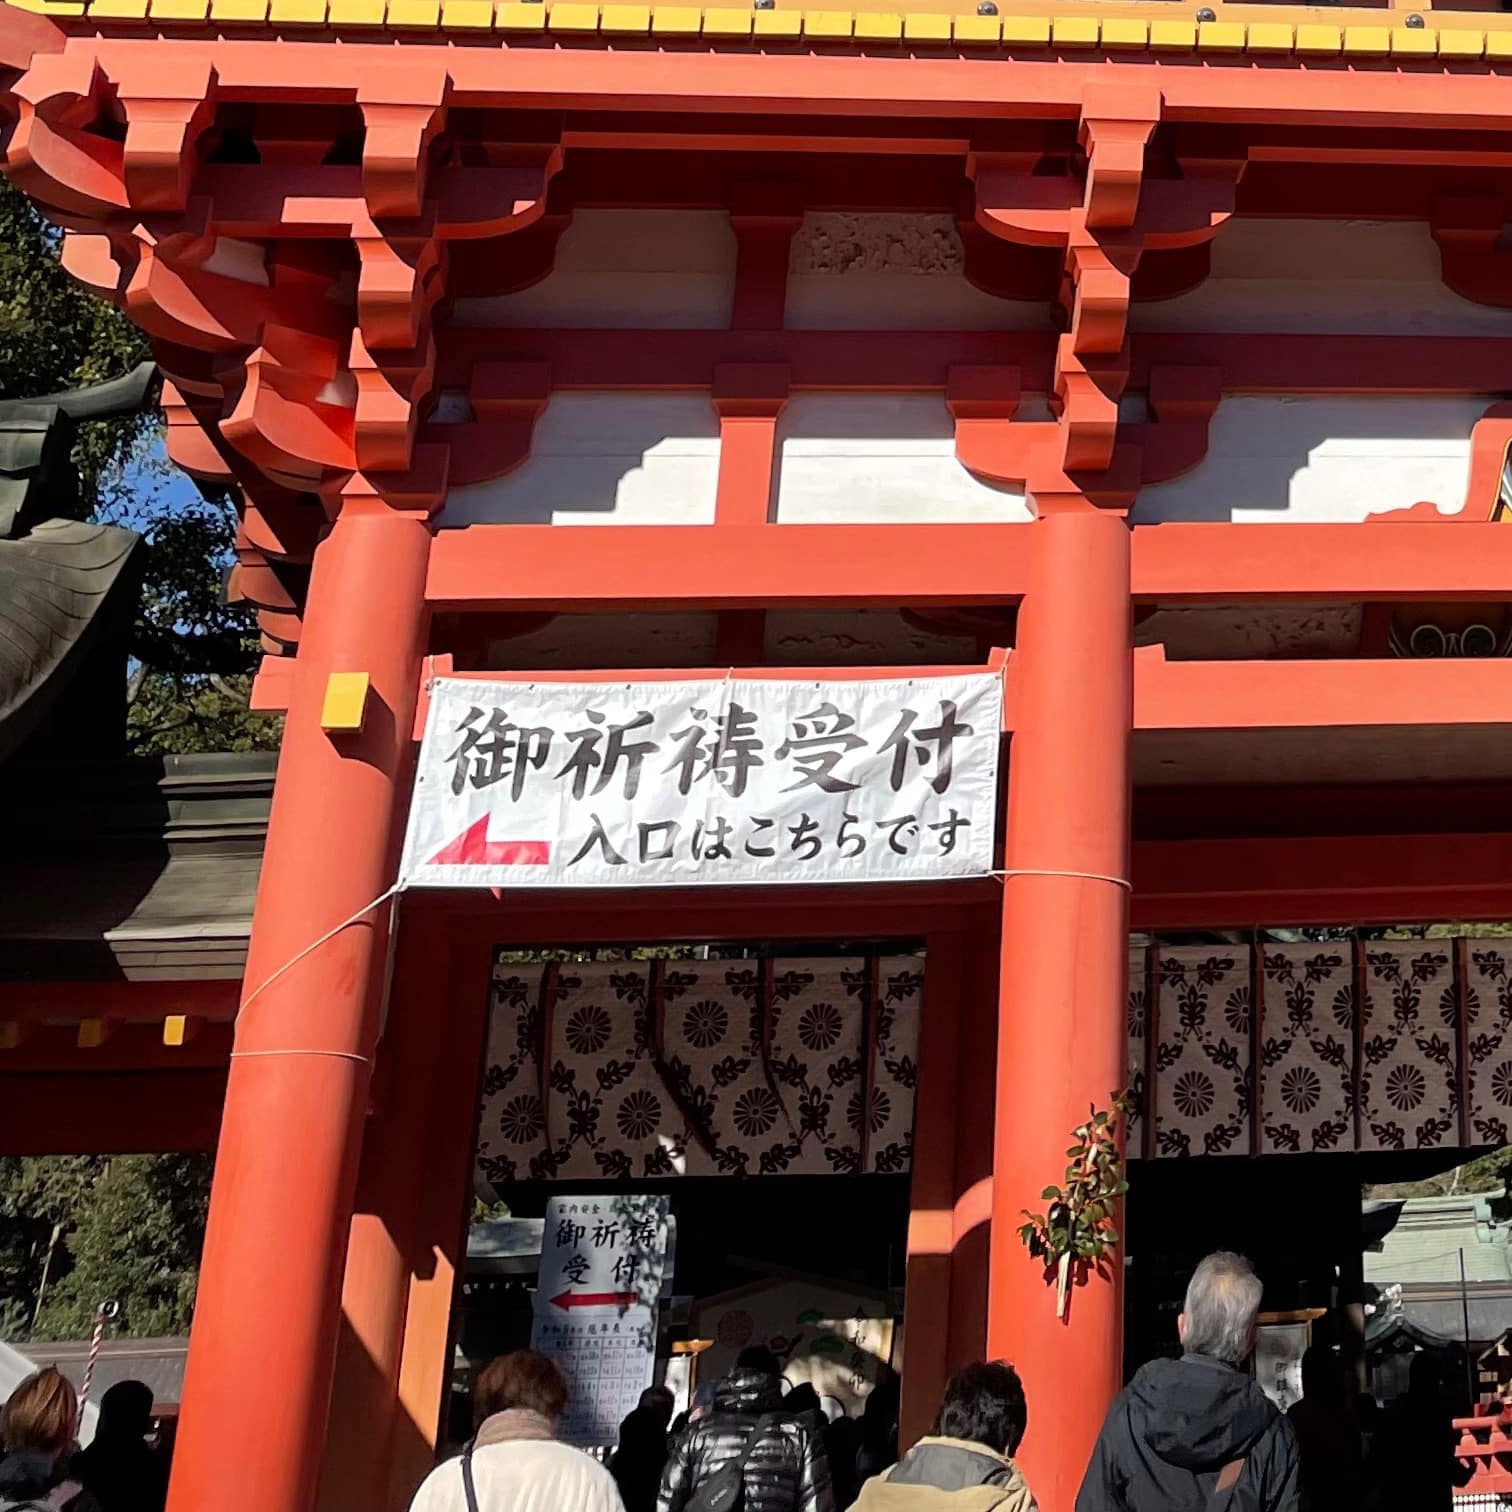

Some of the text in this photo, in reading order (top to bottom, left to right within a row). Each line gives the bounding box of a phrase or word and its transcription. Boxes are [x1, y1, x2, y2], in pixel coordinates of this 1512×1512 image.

[444, 699, 975, 802] 御祈祷受付
[567, 808, 972, 866] 入口はこちらです
[556, 1215, 657, 1249] 御祈祷
[562, 1253, 641, 1285] 受付
